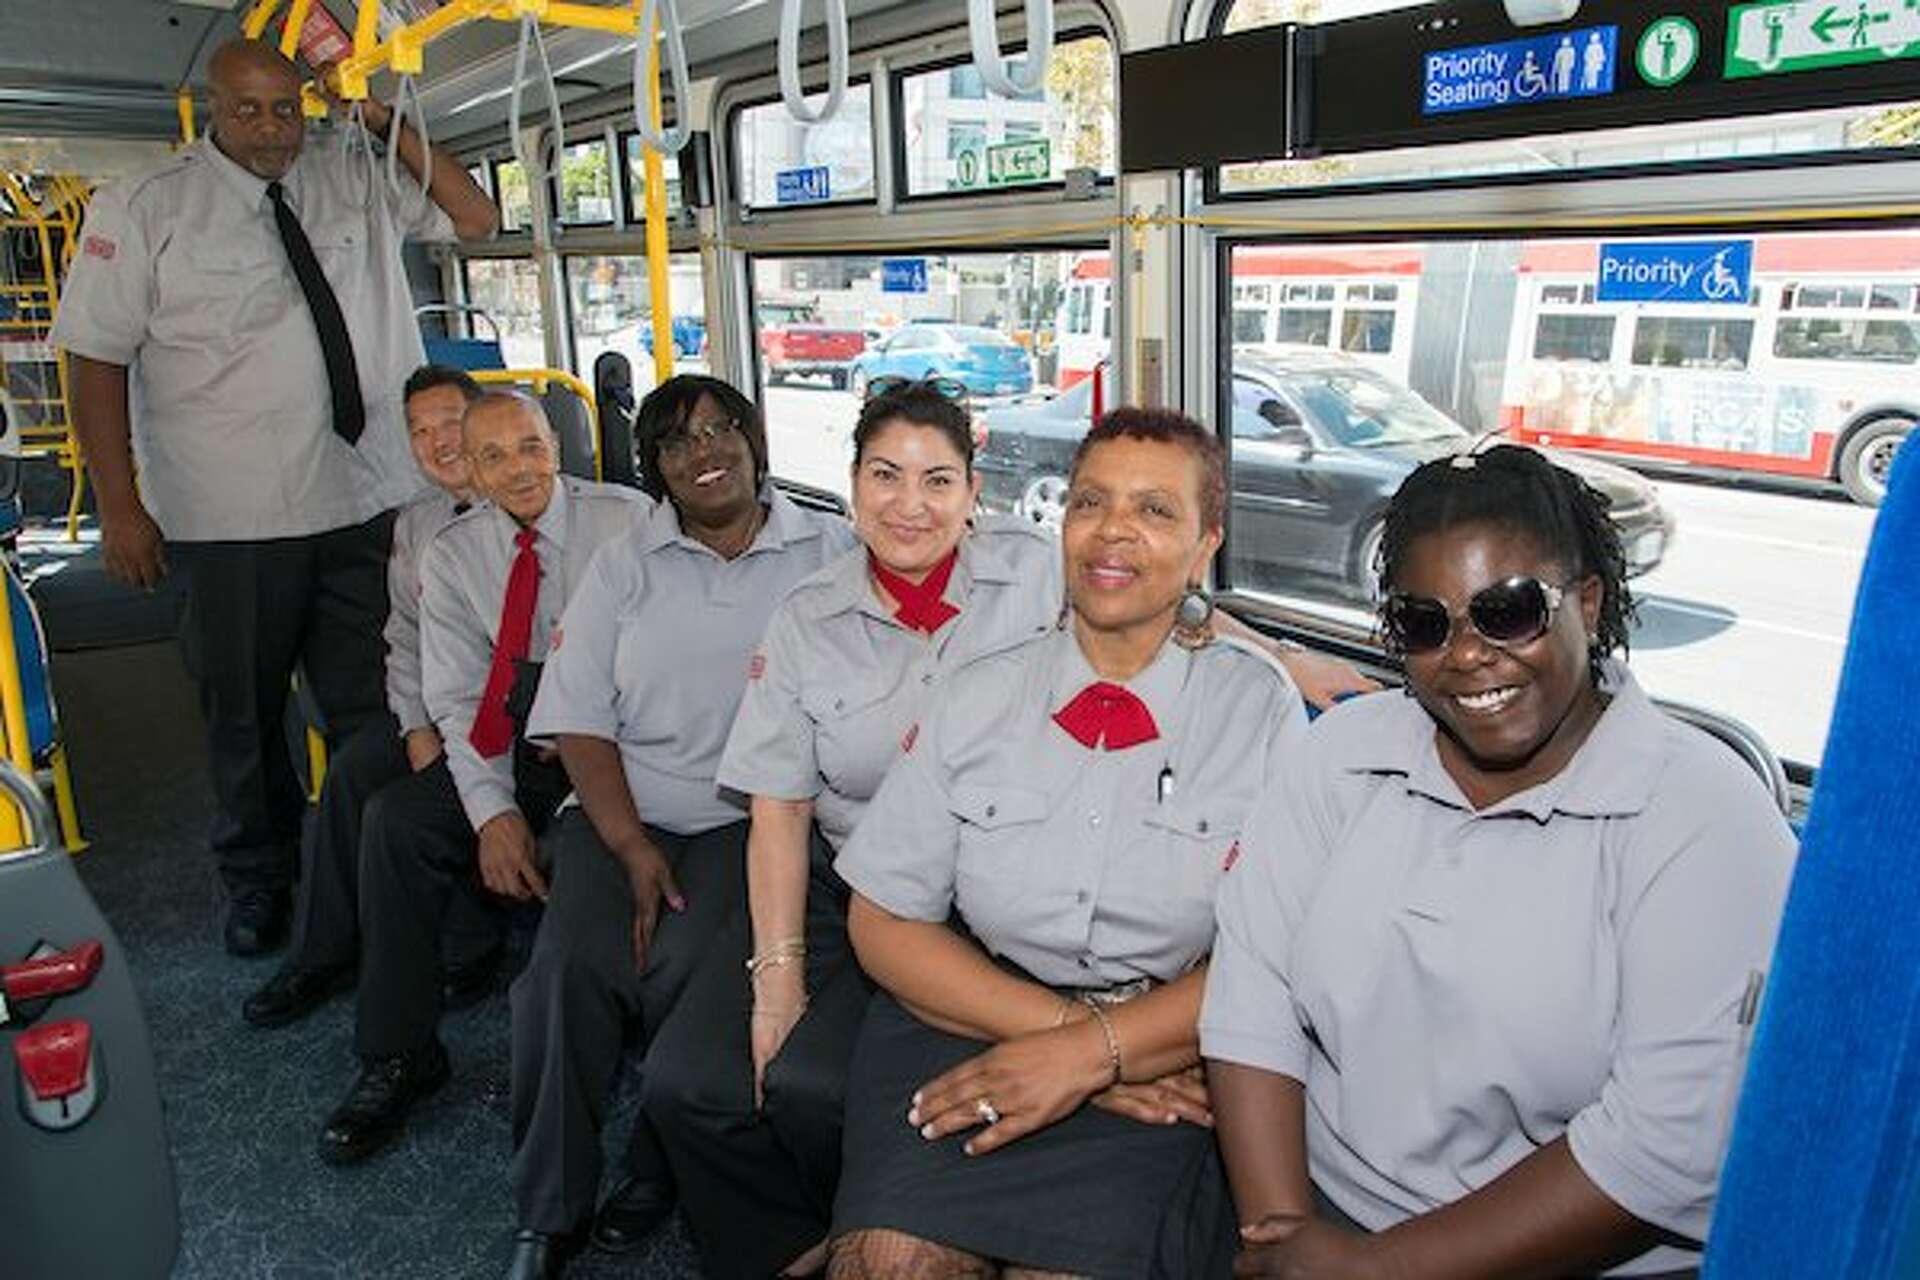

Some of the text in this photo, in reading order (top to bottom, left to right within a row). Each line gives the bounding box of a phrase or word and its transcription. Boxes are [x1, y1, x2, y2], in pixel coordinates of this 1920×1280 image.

[1427, 50, 1508, 80] Priority
[1426, 75, 1511, 105] Seating
[1602, 256, 1693, 288] Priority
